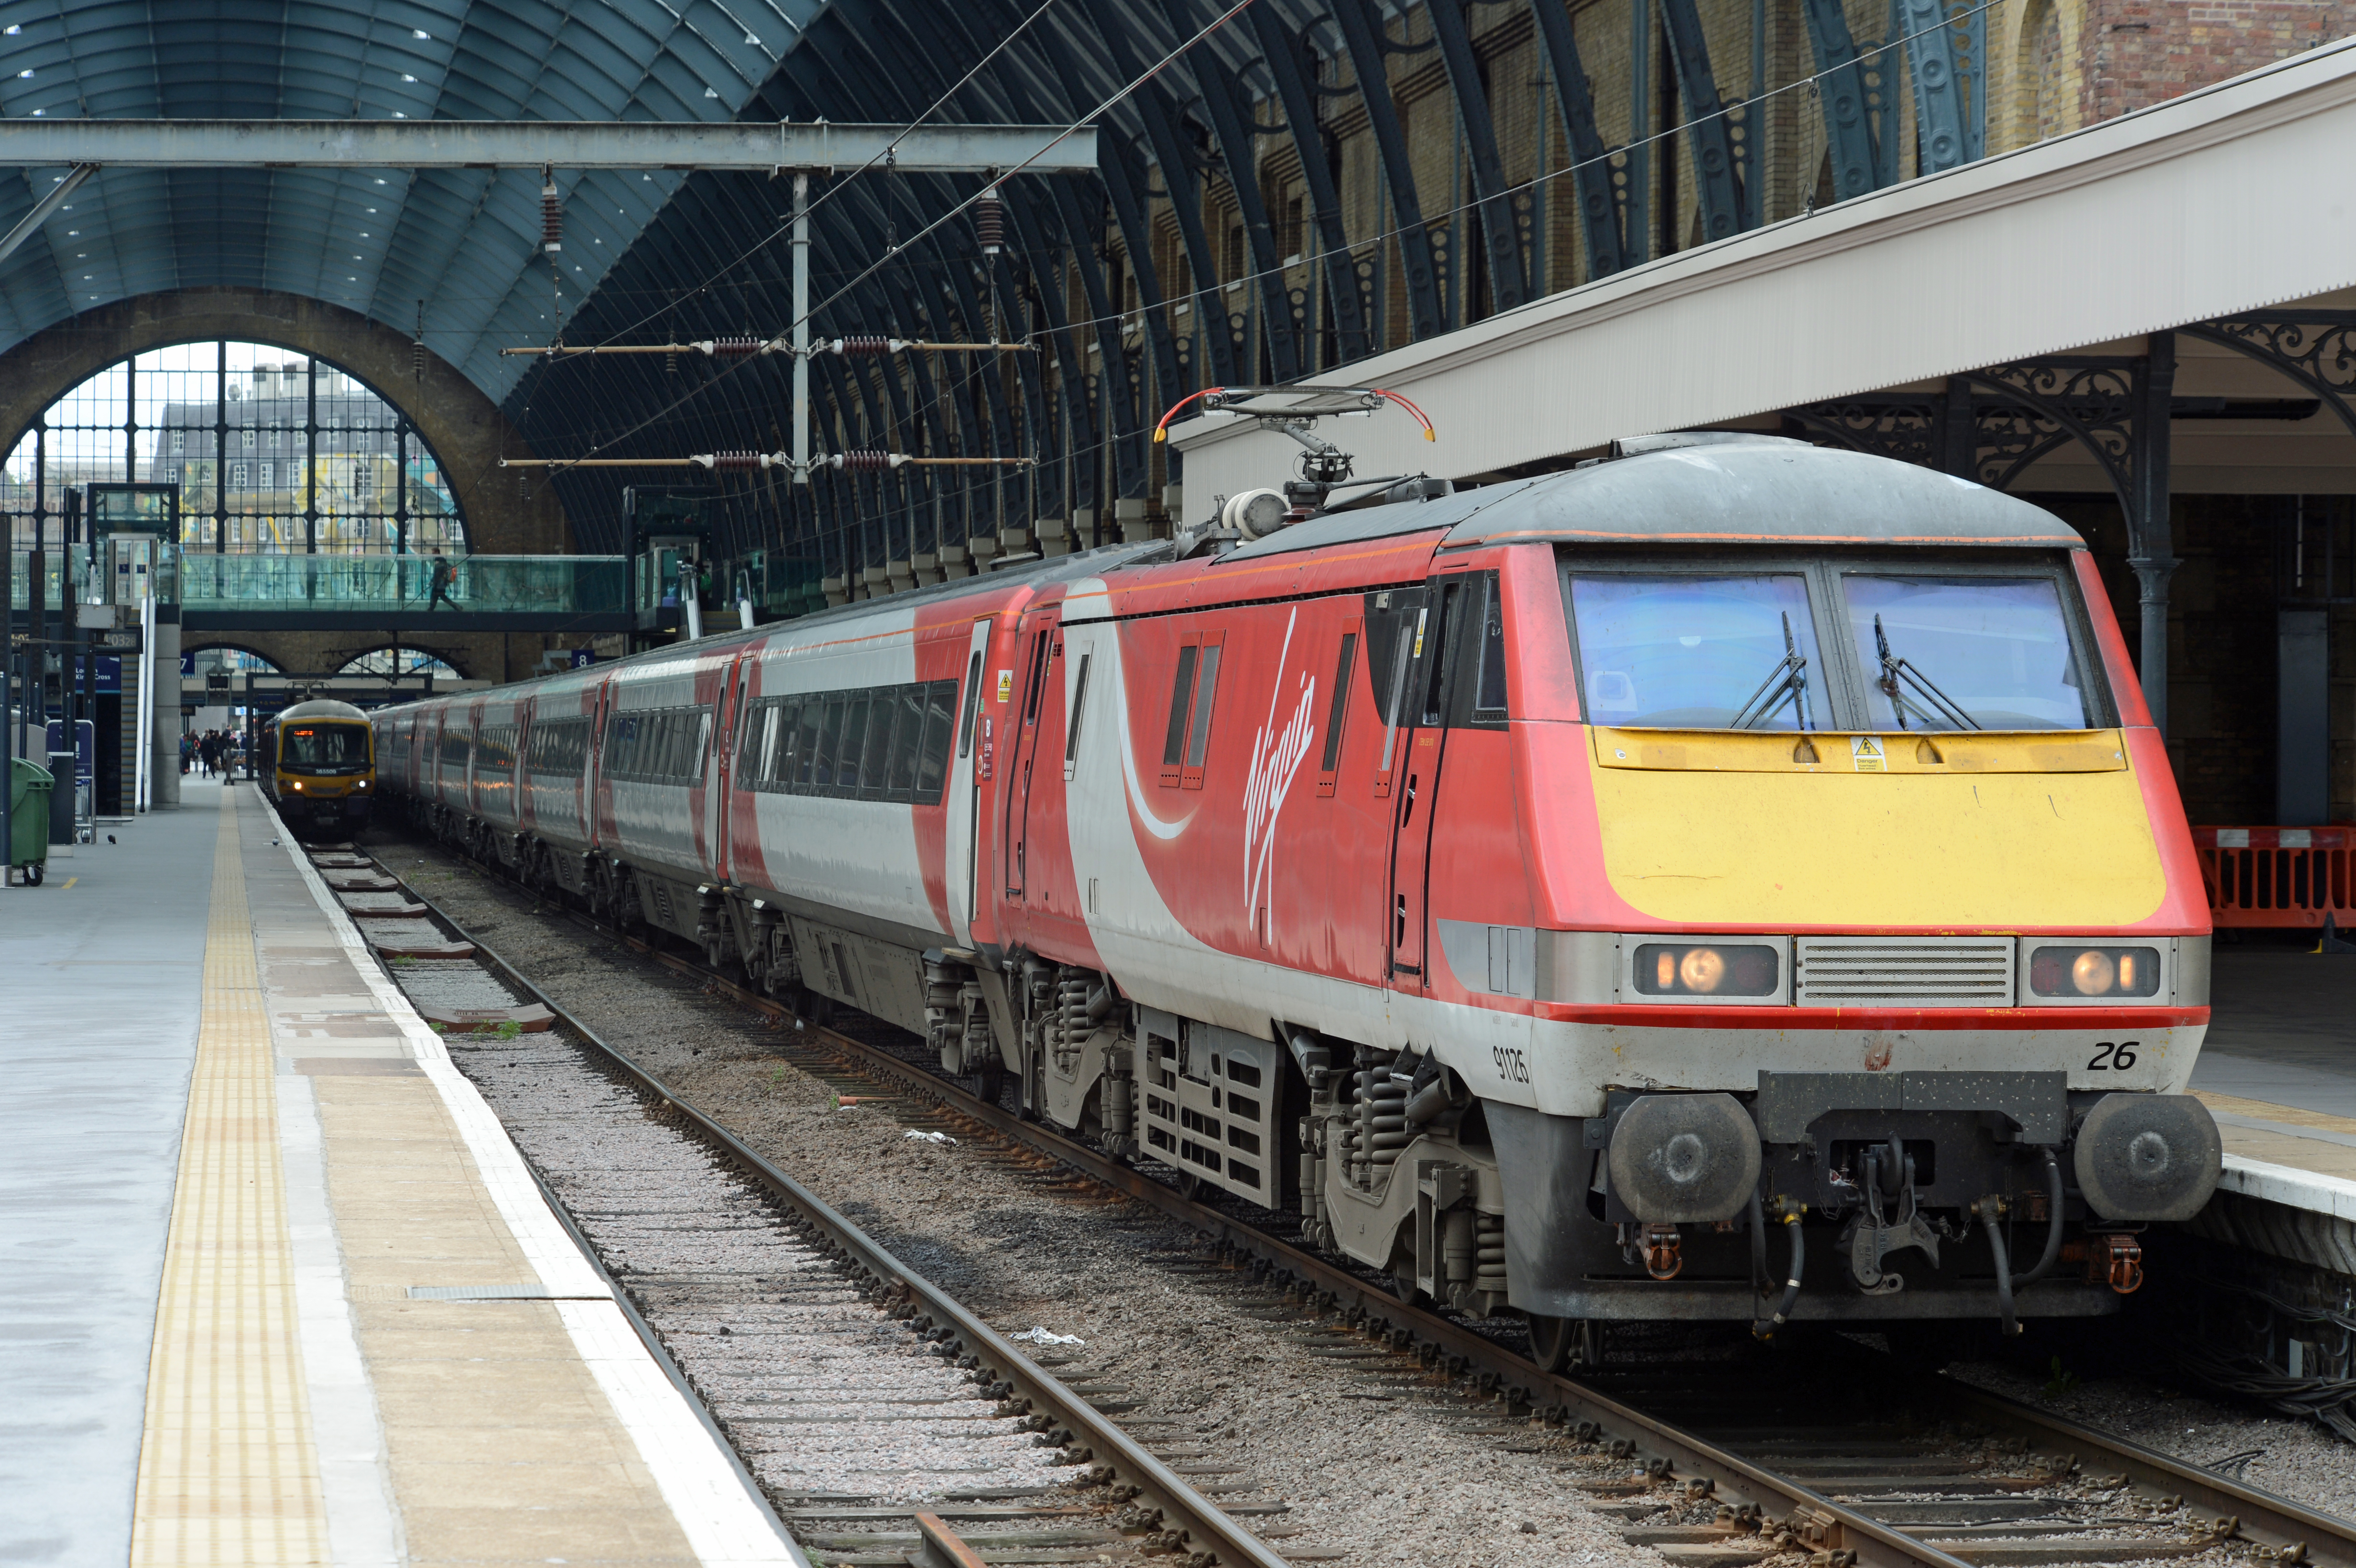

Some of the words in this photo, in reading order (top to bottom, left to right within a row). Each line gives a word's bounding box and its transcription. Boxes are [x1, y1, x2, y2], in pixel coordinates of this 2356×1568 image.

[180, 658, 187, 669] 7
[579, 655, 587, 667] 8
[986, 719, 991, 737] B
[1243, 606, 1314, 946] Virgin
[1493, 1045, 1529, 1084] 91126
[2087, 1041, 2140, 1070] 26
